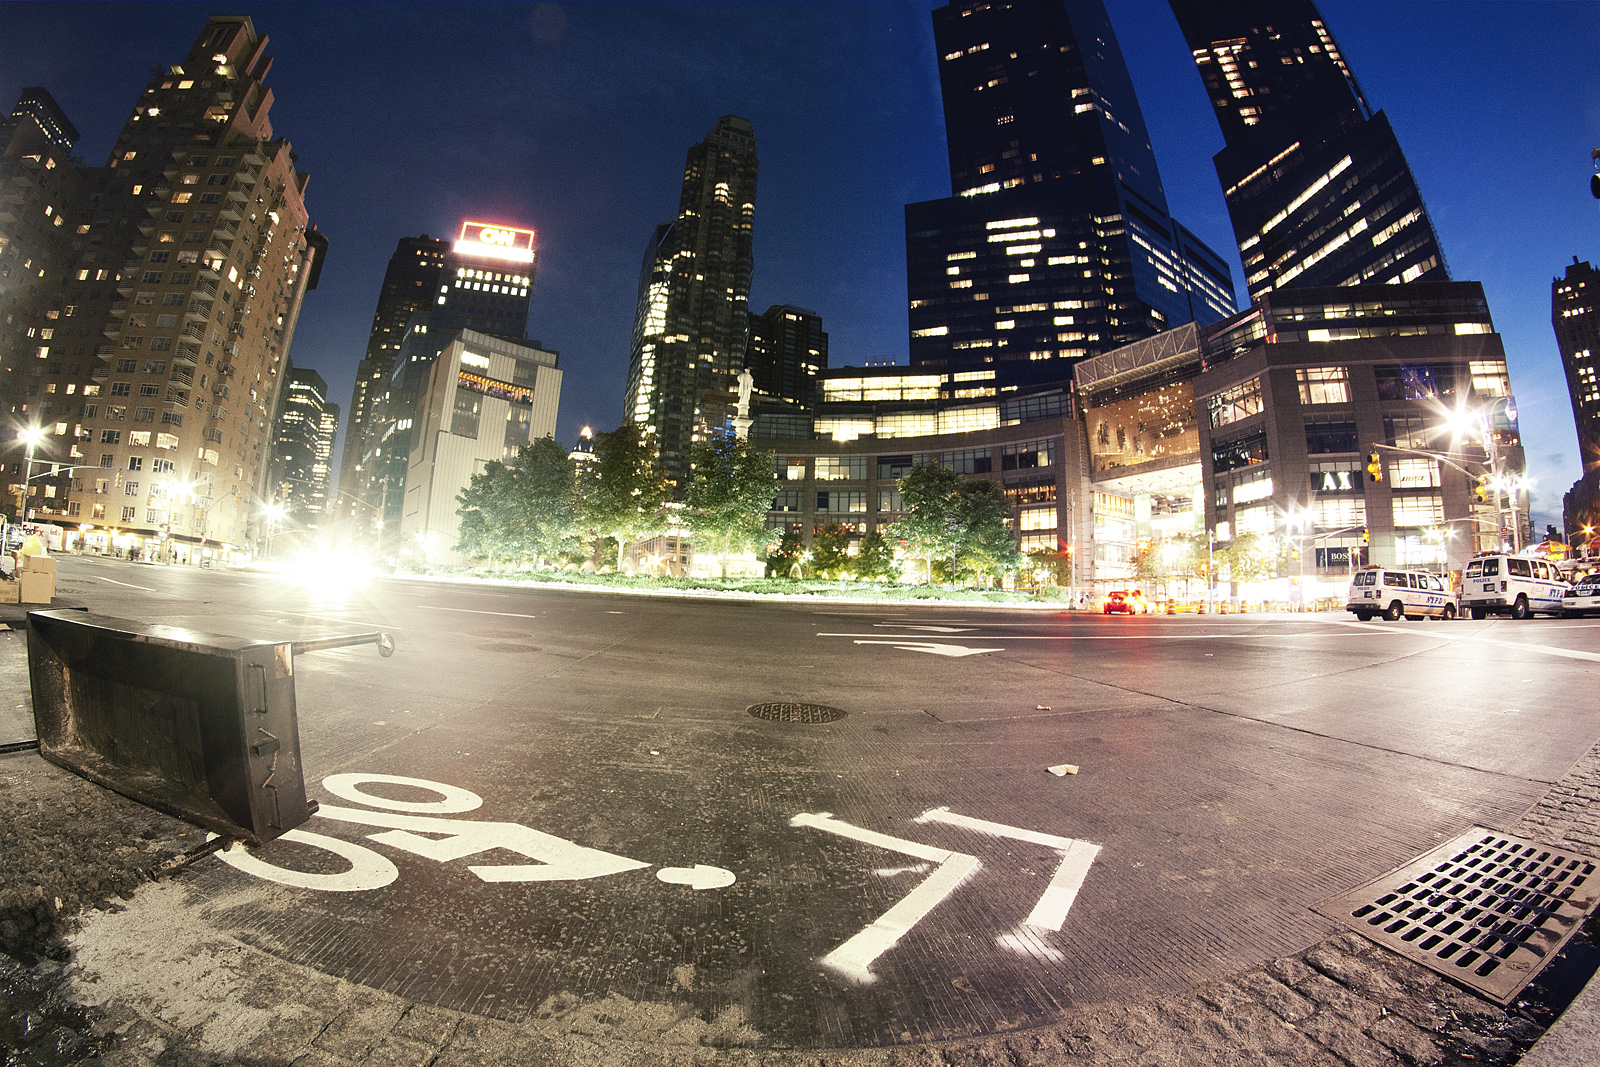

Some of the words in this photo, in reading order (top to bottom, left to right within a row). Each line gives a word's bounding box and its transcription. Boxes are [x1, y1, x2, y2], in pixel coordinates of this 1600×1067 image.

[480, 228, 516, 247] CNN
[1322, 472, 1352, 491] AX
[23, 525, 44, 537] FedEx
